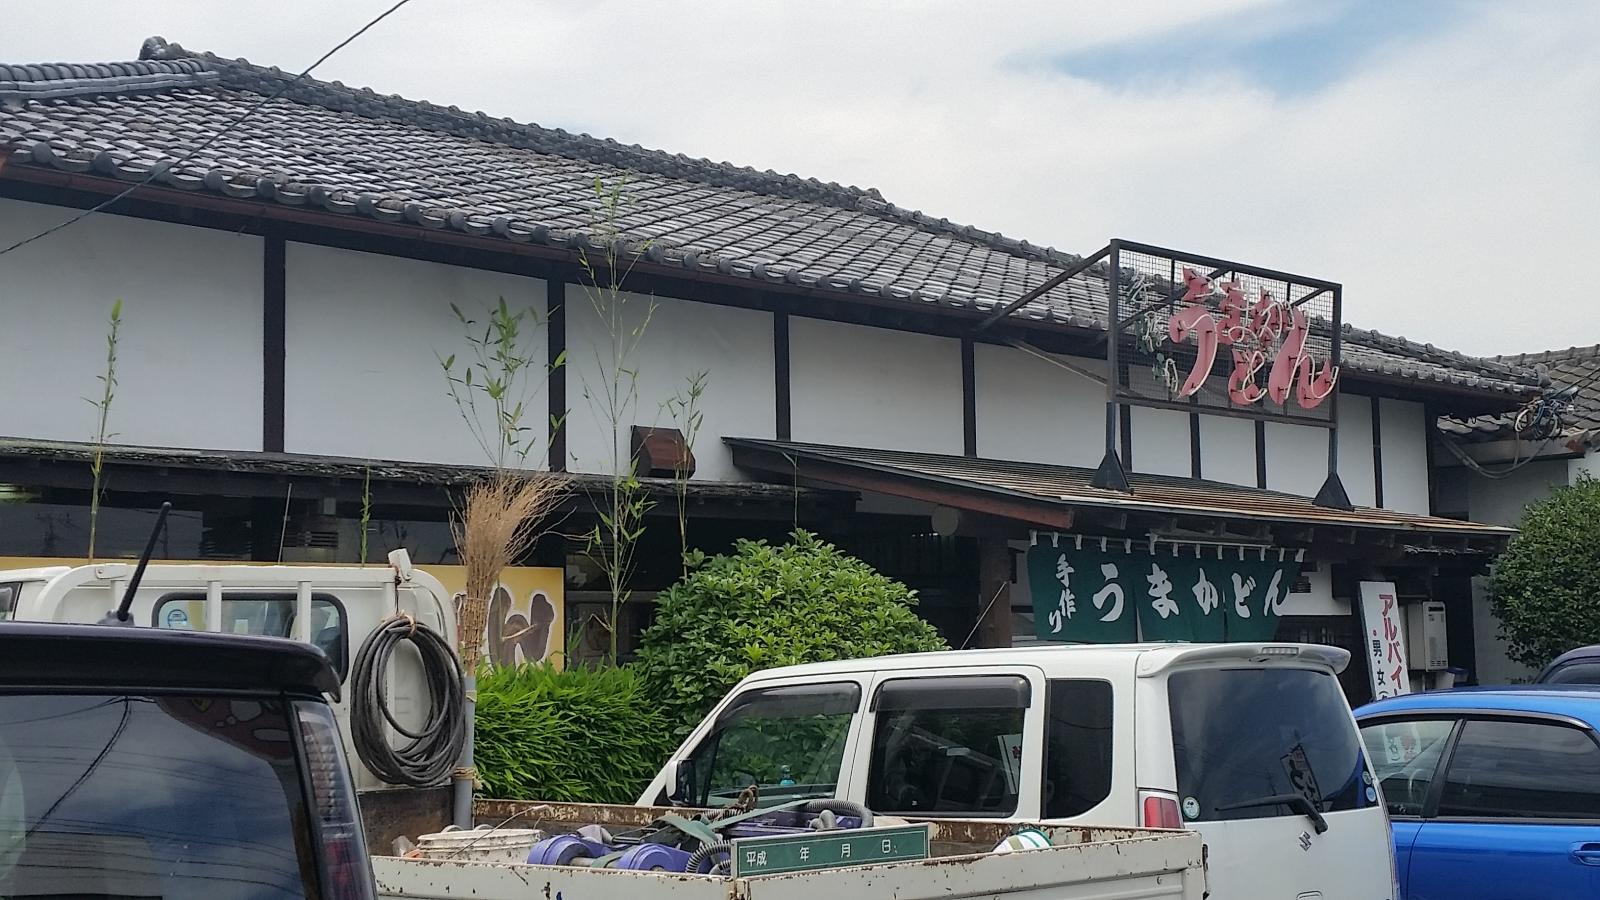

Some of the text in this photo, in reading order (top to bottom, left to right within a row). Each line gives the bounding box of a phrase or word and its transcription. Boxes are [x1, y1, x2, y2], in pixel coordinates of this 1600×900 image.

[1048, 553, 1076, 634] 手作り
[1092, 562, 1290, 623] うまかどん
[1378, 594, 1403, 696] アルバイ
[746, 850, 767, 867] 平成
[799, 846, 810, 862] 年
[840, 843, 851, 858] 月
